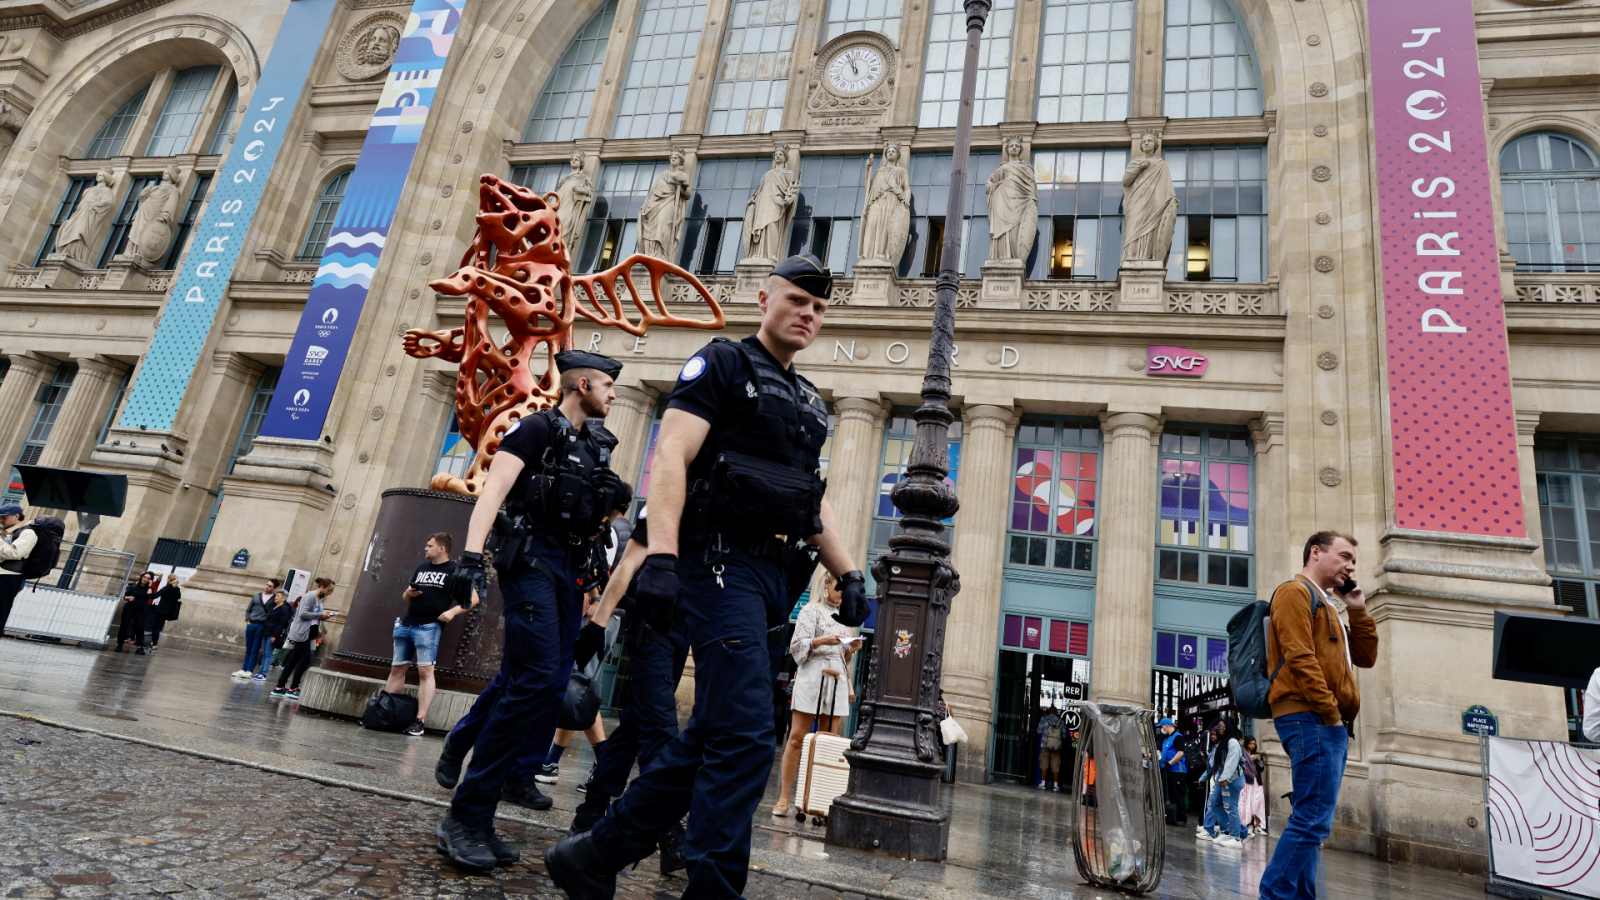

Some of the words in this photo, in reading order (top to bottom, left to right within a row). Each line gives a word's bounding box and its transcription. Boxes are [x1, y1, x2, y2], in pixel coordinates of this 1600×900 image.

[1402, 27, 1452, 153] 2024
[185, 199, 243, 303] PARiS
[233, 97, 285, 184] 2024
[1411, 176, 1467, 333] PARiS
[1149, 355, 1205, 371] SNCF
[415, 571, 447, 586] DIESEL
[1065, 685, 1080, 695] RER
[1065, 714, 1076, 726] M
